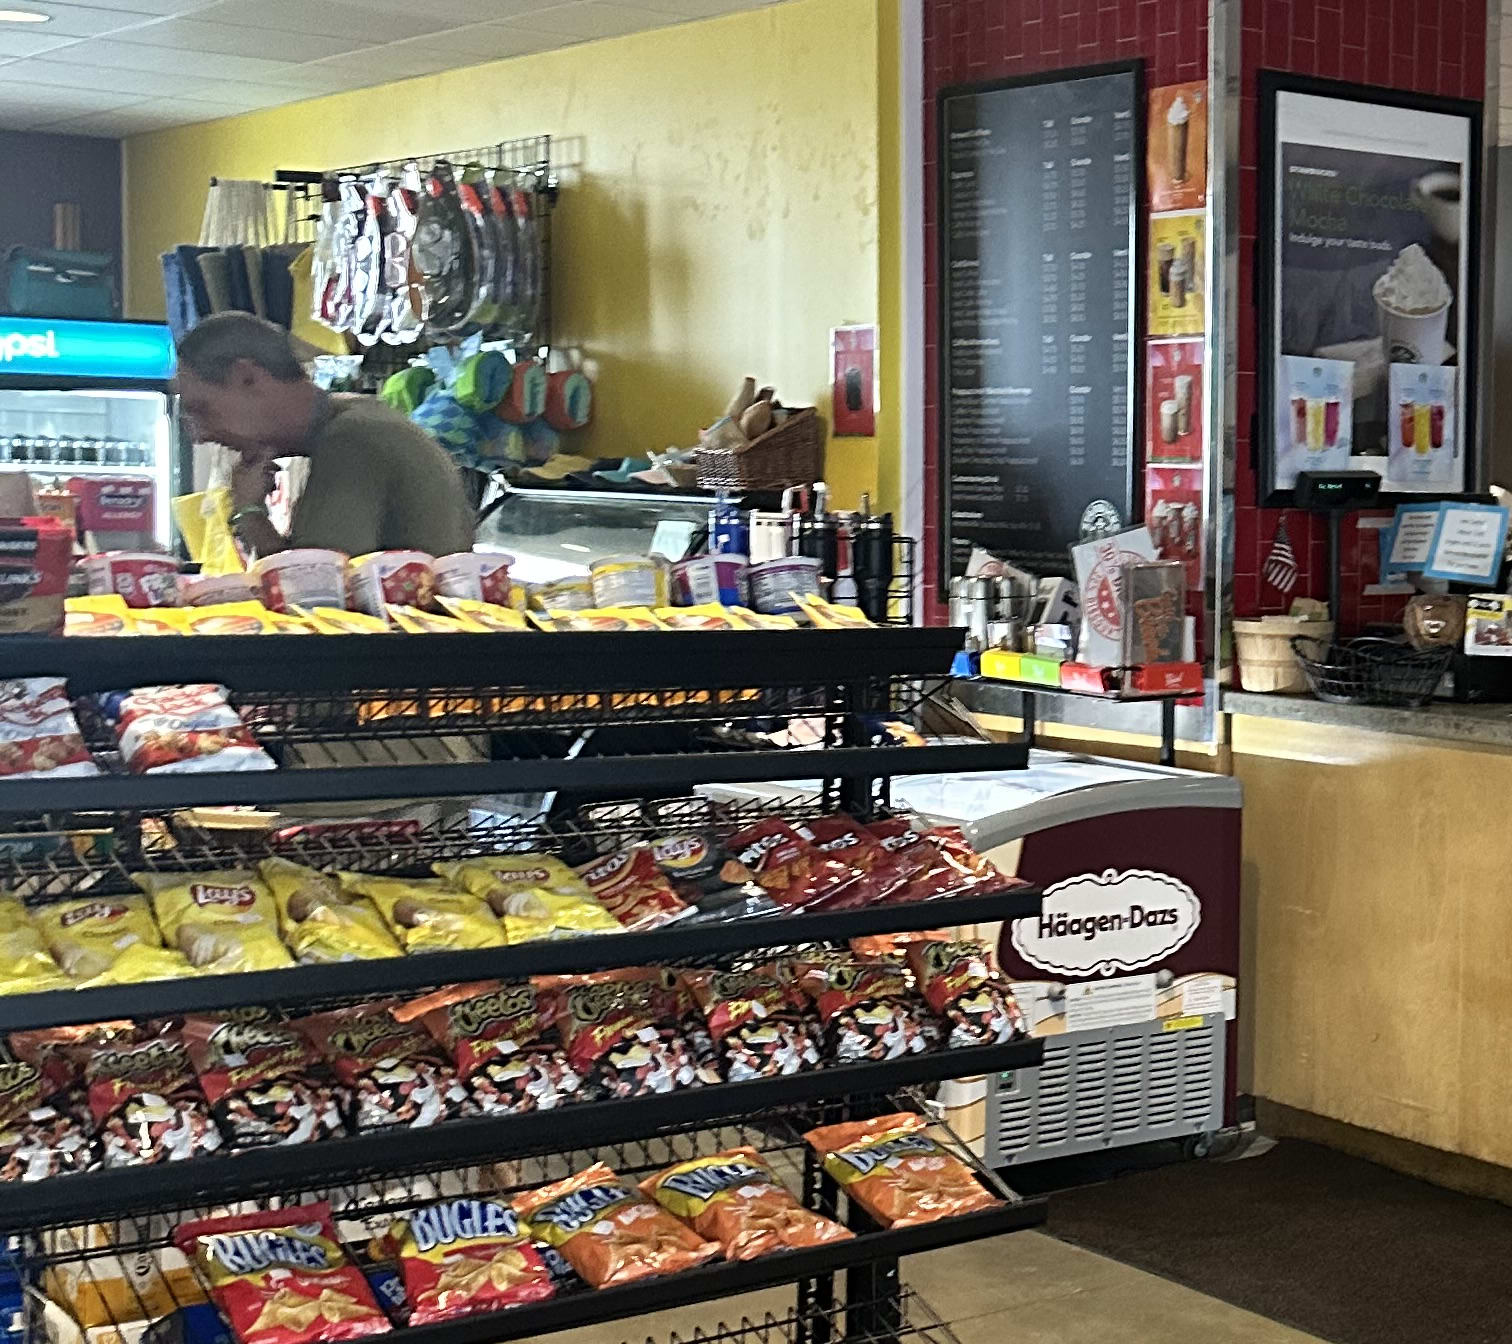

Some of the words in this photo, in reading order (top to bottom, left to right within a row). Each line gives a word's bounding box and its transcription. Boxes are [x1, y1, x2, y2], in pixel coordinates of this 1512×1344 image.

[0, 330, 54, 361] psi
[1038, 905, 1178, 941] Häagen-Dazs
[410, 1199, 520, 1253] BUGLES
[210, 1231, 329, 1274] BUGLES
